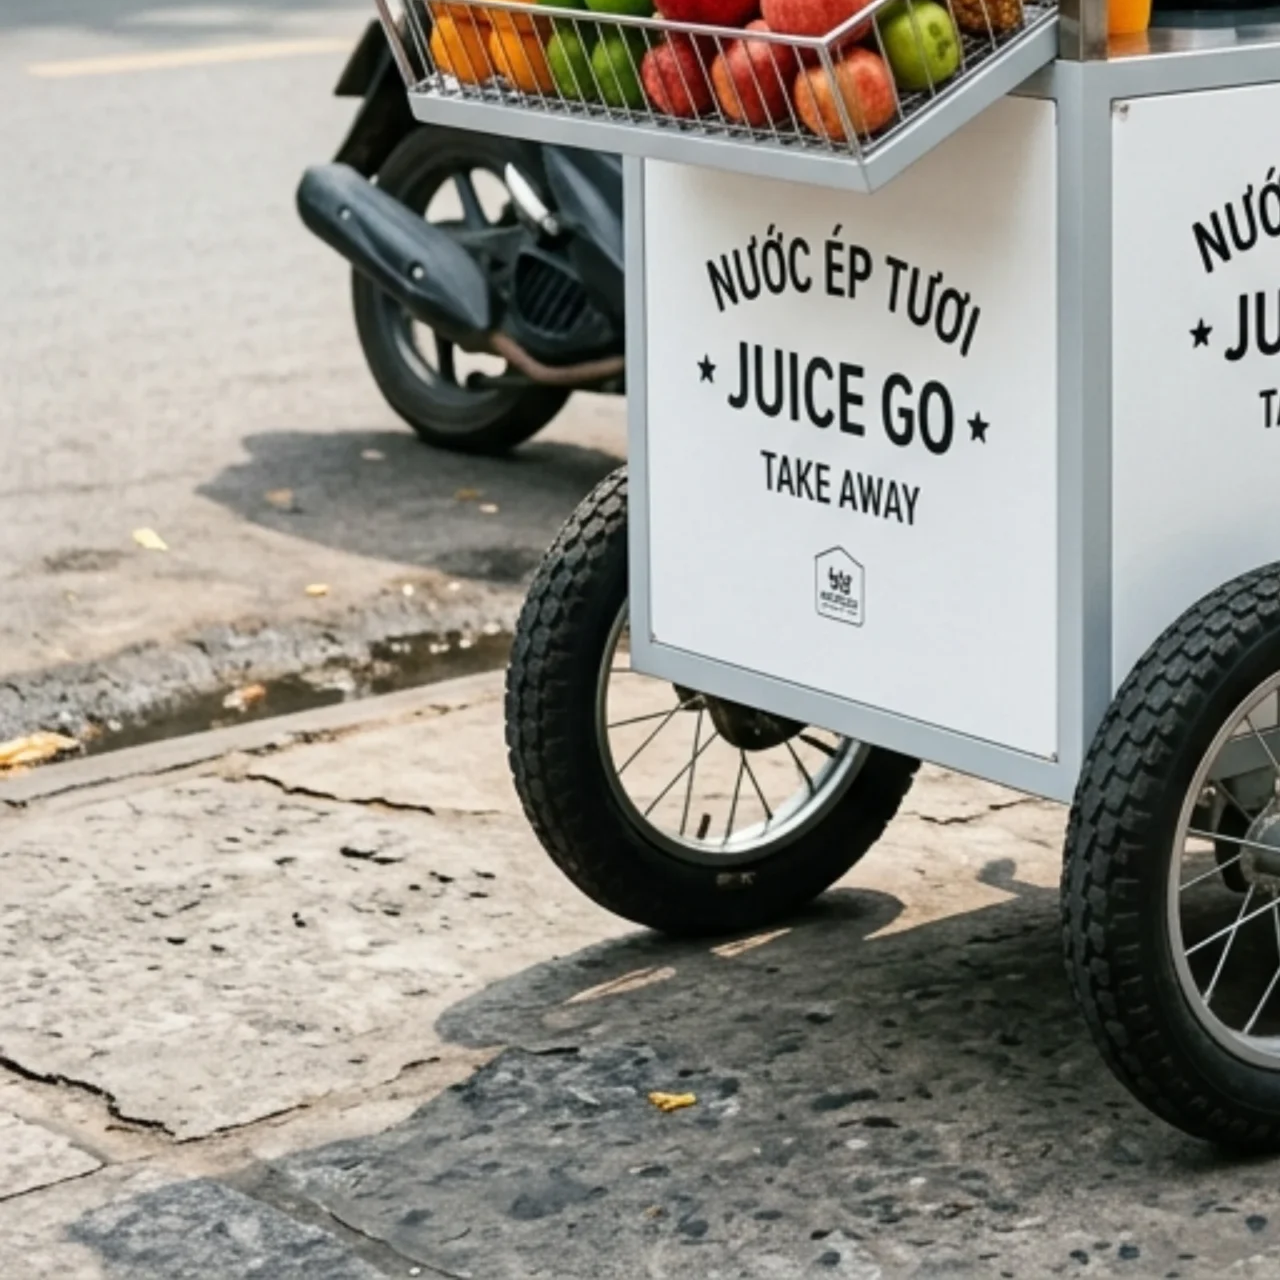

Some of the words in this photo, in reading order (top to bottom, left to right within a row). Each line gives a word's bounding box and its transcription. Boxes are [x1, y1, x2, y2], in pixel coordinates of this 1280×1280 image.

[707, 224, 812, 311] NƯỚC
[825, 224, 872, 298] ÉP
[886, 255, 980, 356] TƯƠI
[728, 342, 864, 436] JUICE
[882, 373, 953, 454] GO
[761, 451, 830, 503] TAKE
[840, 470, 919, 525] AWAY
